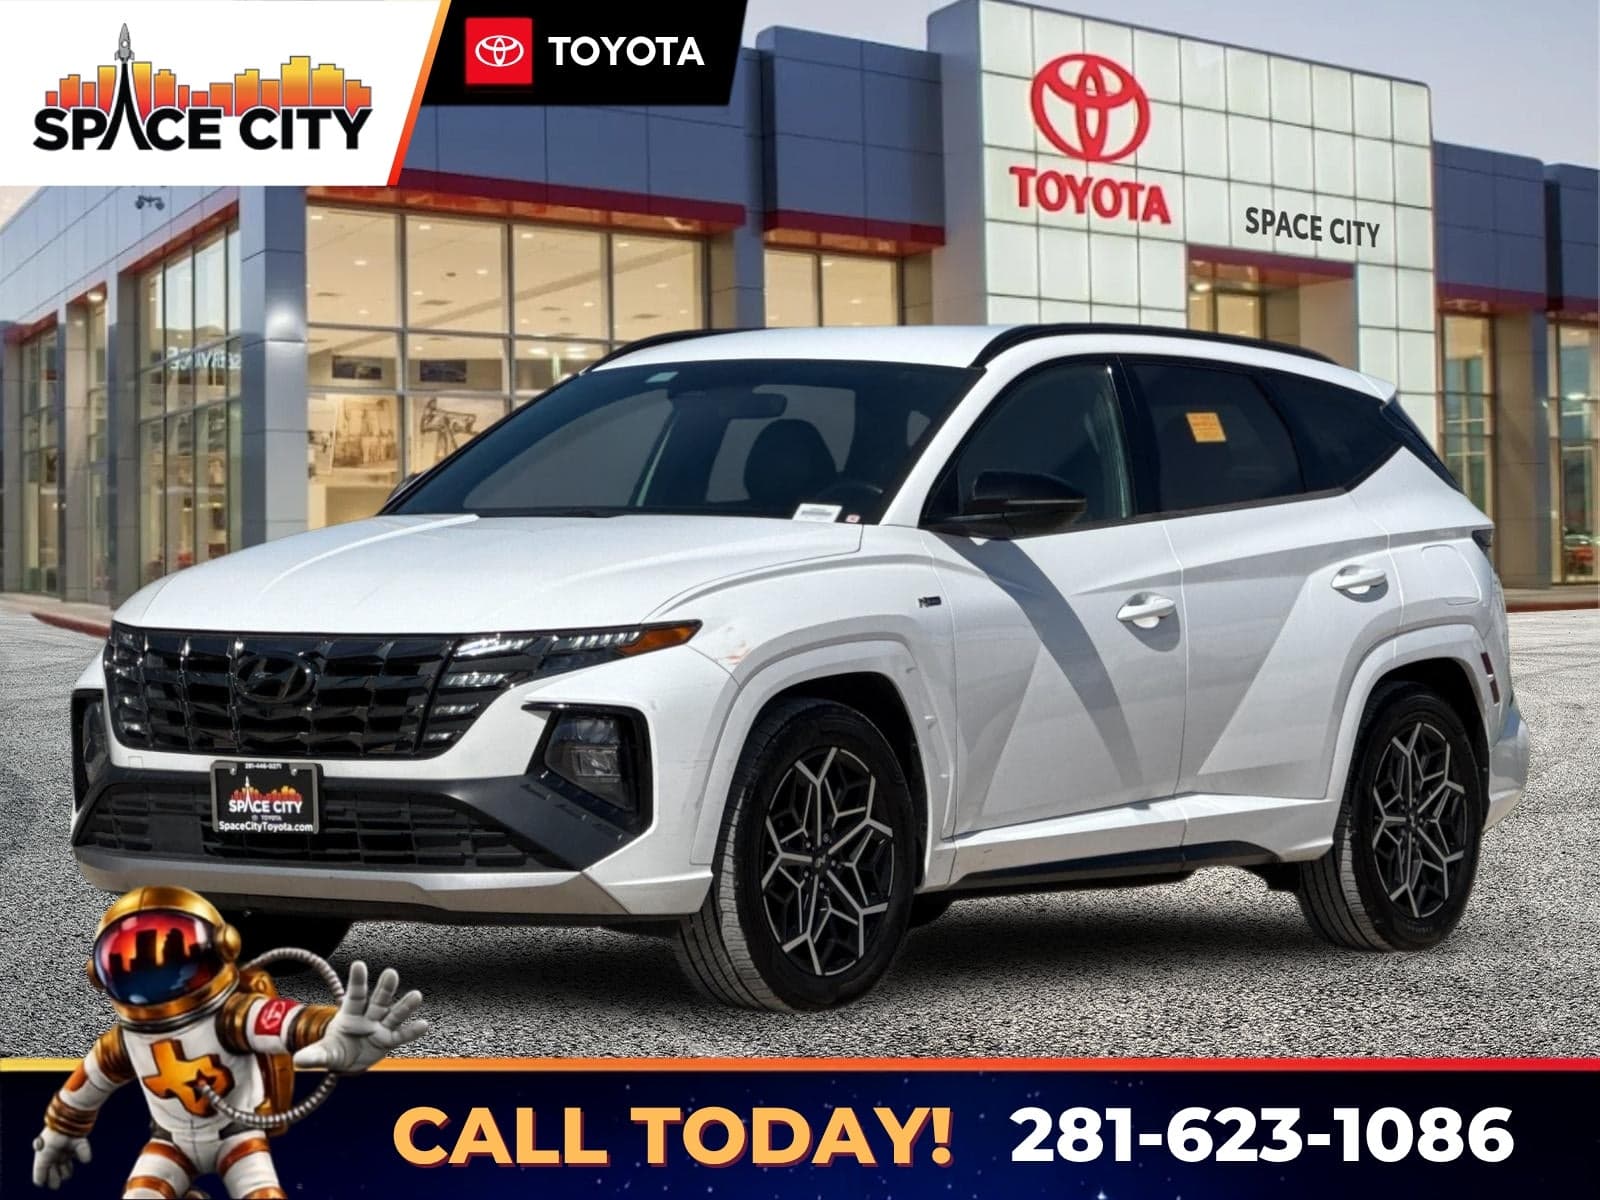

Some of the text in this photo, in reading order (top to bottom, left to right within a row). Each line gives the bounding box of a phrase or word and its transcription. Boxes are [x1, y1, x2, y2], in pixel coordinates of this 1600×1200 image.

[1009, 166, 1172, 225] TOYOTA
[1245, 206, 1381, 248] SPACE CITY
[229, 799, 303, 813] SPACE CITY
[219, 821, 313, 833] SpaceCityToyota.com
